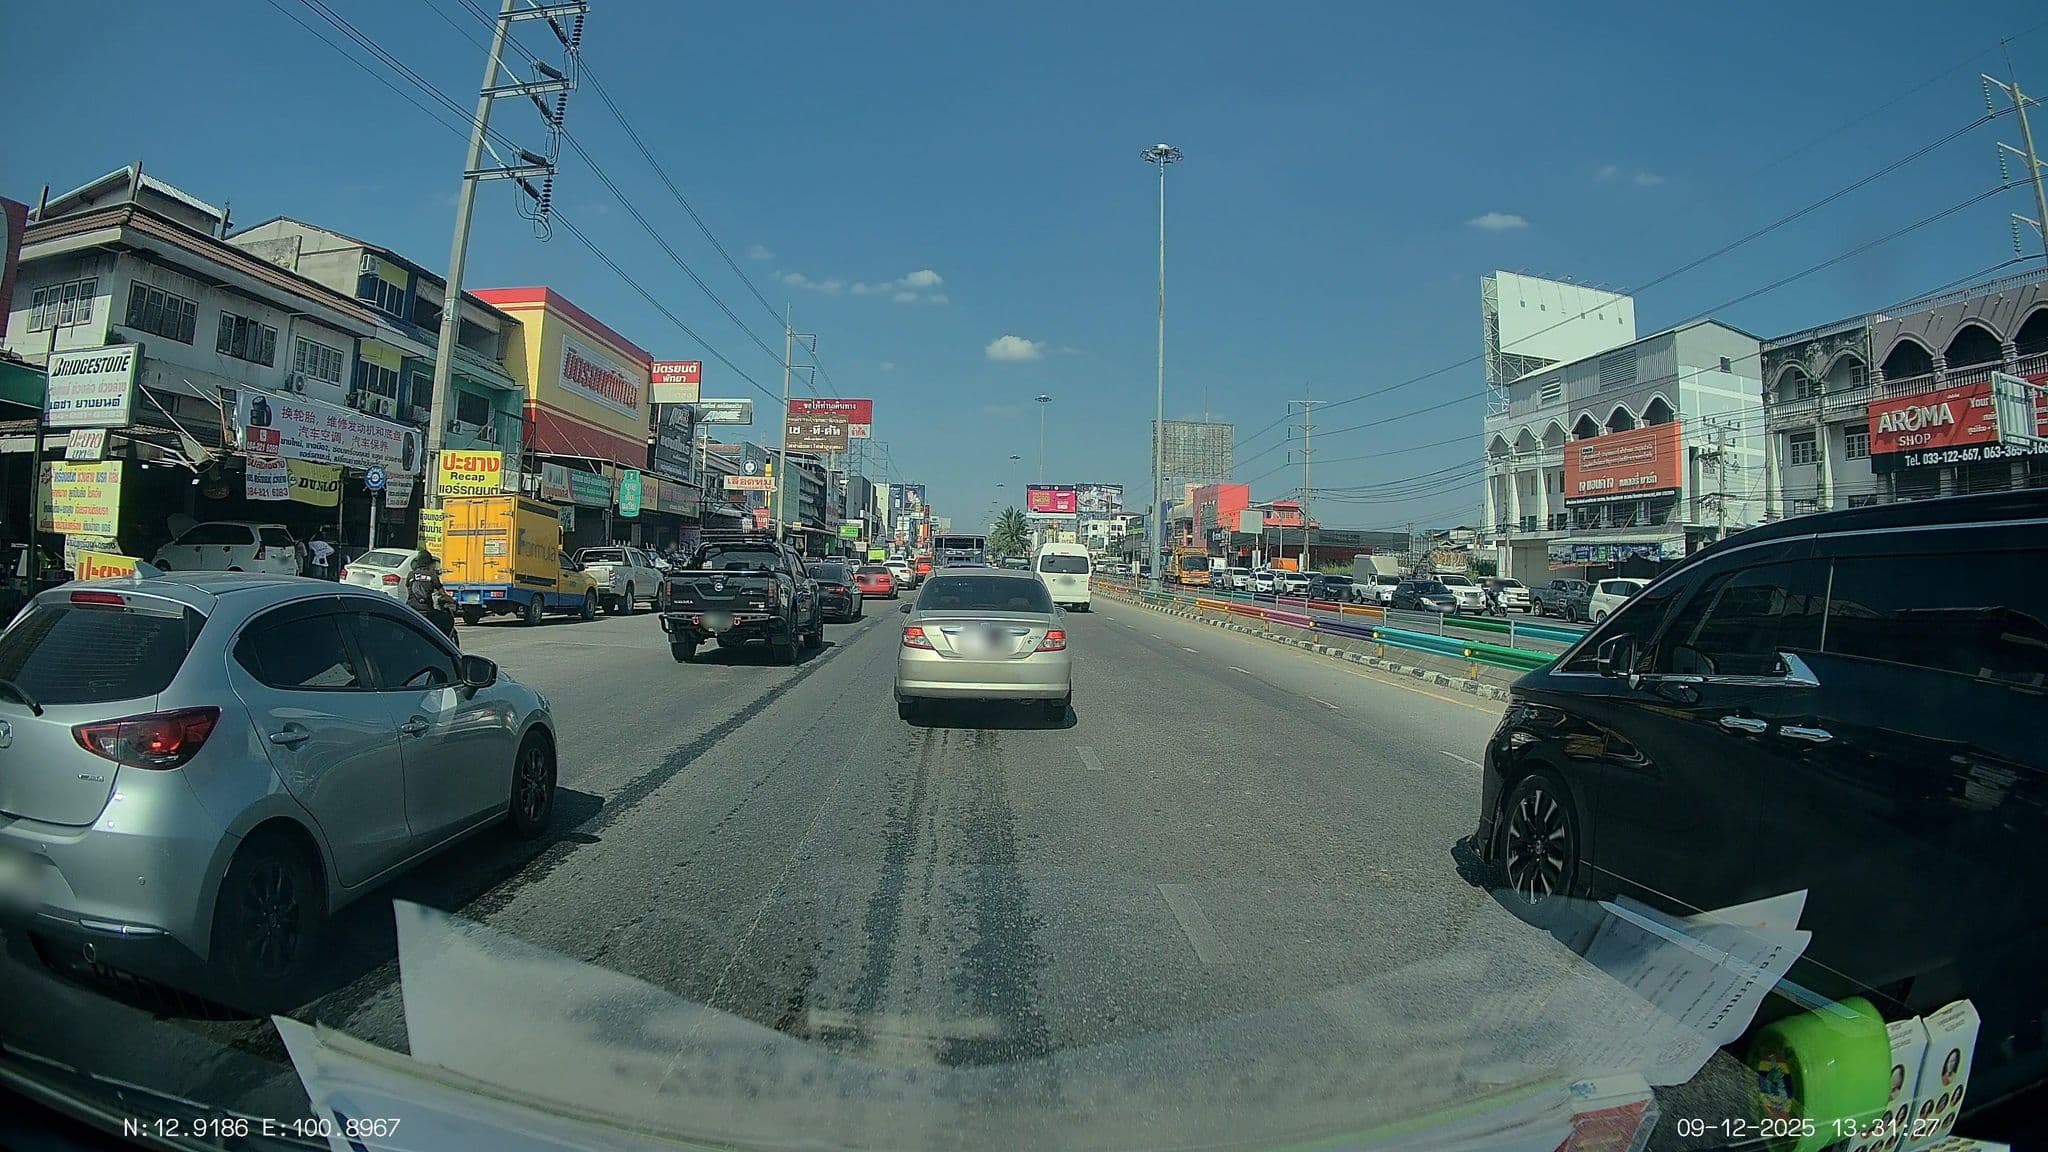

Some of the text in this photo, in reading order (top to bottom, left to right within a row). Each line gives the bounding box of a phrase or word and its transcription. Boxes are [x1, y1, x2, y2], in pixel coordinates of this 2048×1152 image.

[51, 355, 131, 377] BRIDGESTONE
[652, 362, 697, 373] มิตรยนต์
[662, 373, 686, 383] พัทยา
[76, 394, 122, 408] ยางยนต์
[1970, 397, 1990, 408] Your
[1878, 402, 1955, 433] AROMA
[1899, 433, 1931, 447] SHOP
[443, 453, 500, 472] ปะยาง
[1905, 455, 1921, 467] Tel.
[1923, 447, 1981, 465] 033-122-667,
[299, 477, 341, 492] DUNLO
[450, 472, 485, 483] Recap
[439, 484, 499, 495] แอร์รถยนต์
[77, 556, 131, 581] ปะย
